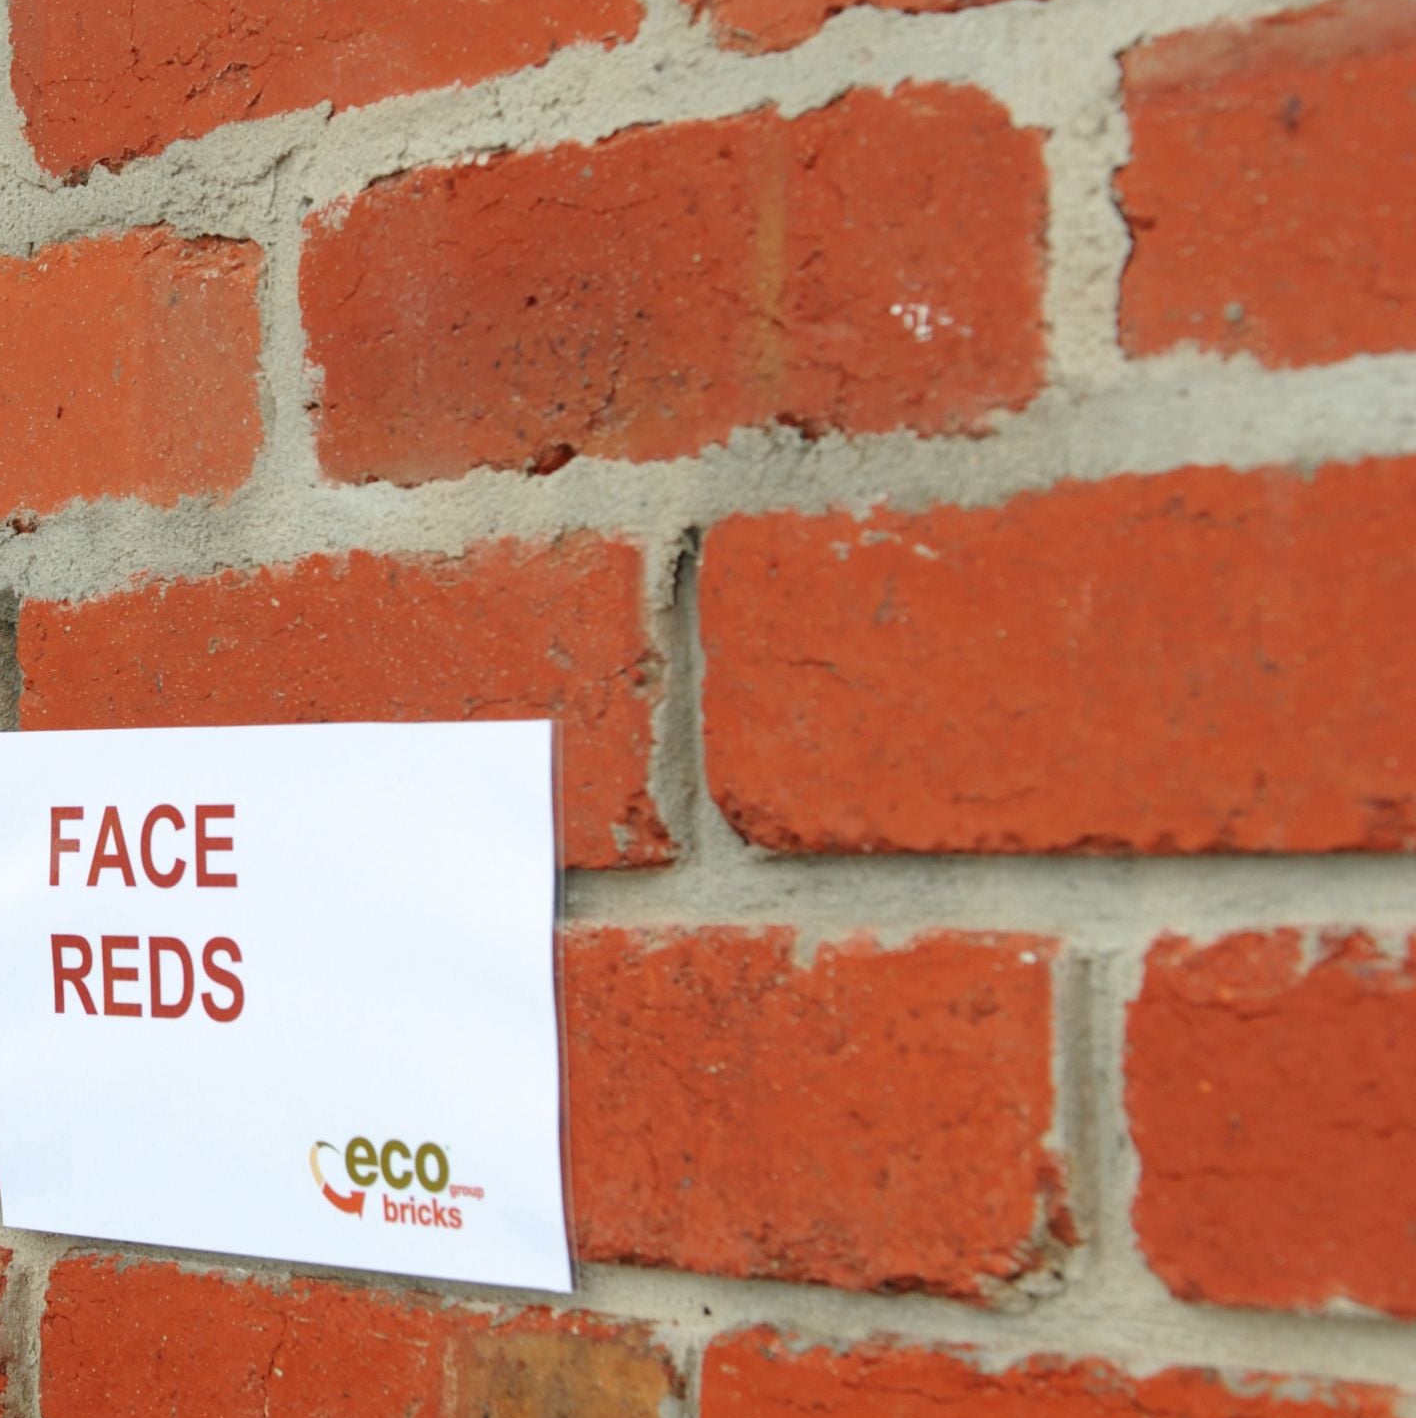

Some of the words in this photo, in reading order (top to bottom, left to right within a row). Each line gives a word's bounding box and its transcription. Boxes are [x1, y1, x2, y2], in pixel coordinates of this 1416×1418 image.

[48, 803, 239, 889] FACE
[50, 933, 245, 1023] REDS
[345, 1136, 450, 1193] eco
[449, 1183, 485, 1201] group
[383, 1194, 462, 1229] bricks
